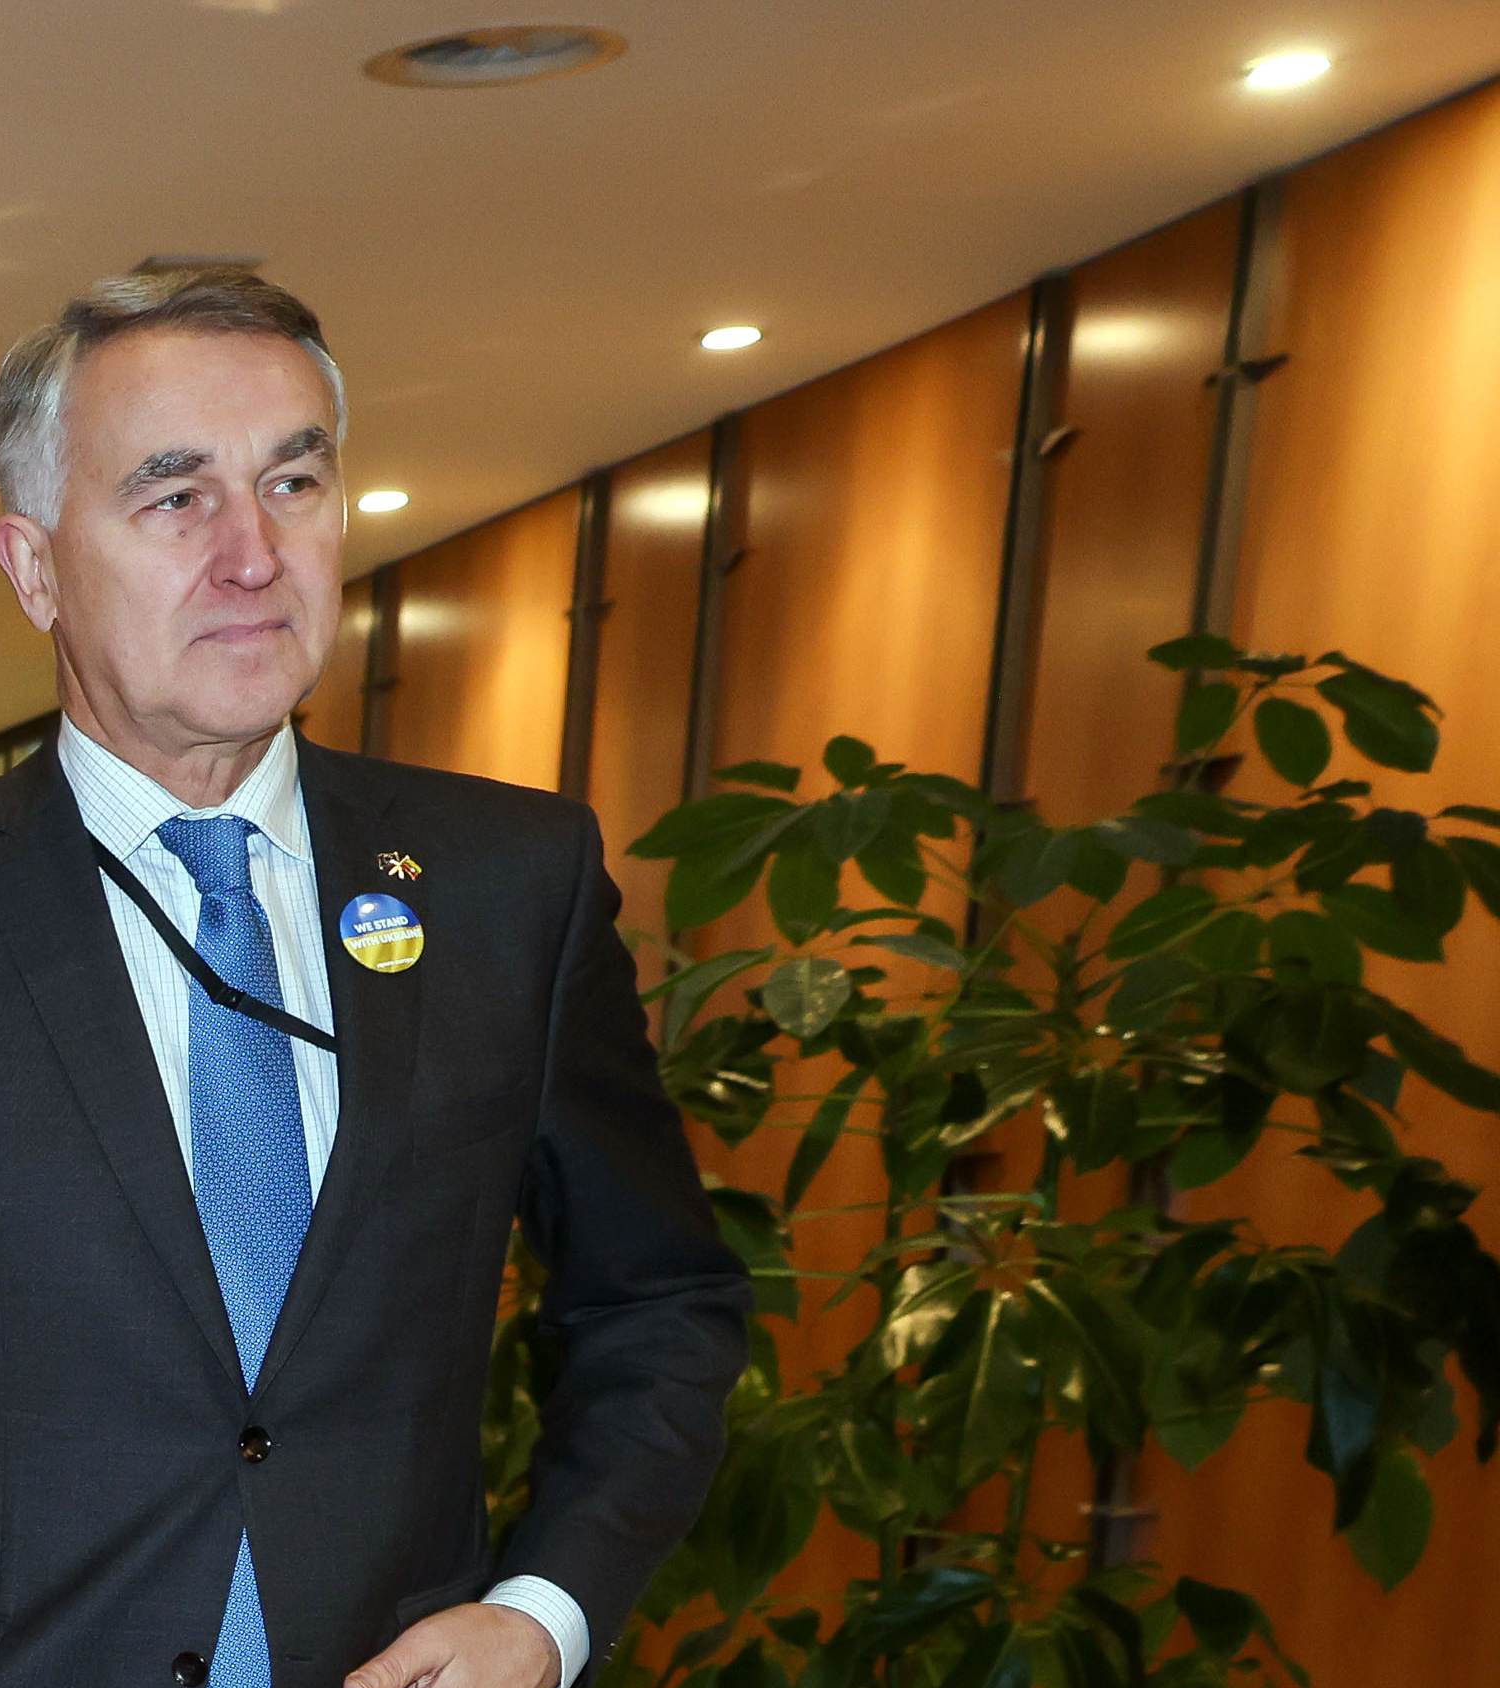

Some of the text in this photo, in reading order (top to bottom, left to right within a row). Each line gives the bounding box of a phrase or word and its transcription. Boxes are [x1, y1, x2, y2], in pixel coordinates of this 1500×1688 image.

[353, 915, 409, 933] WE STAND
[350, 934, 380, 949] WITH
